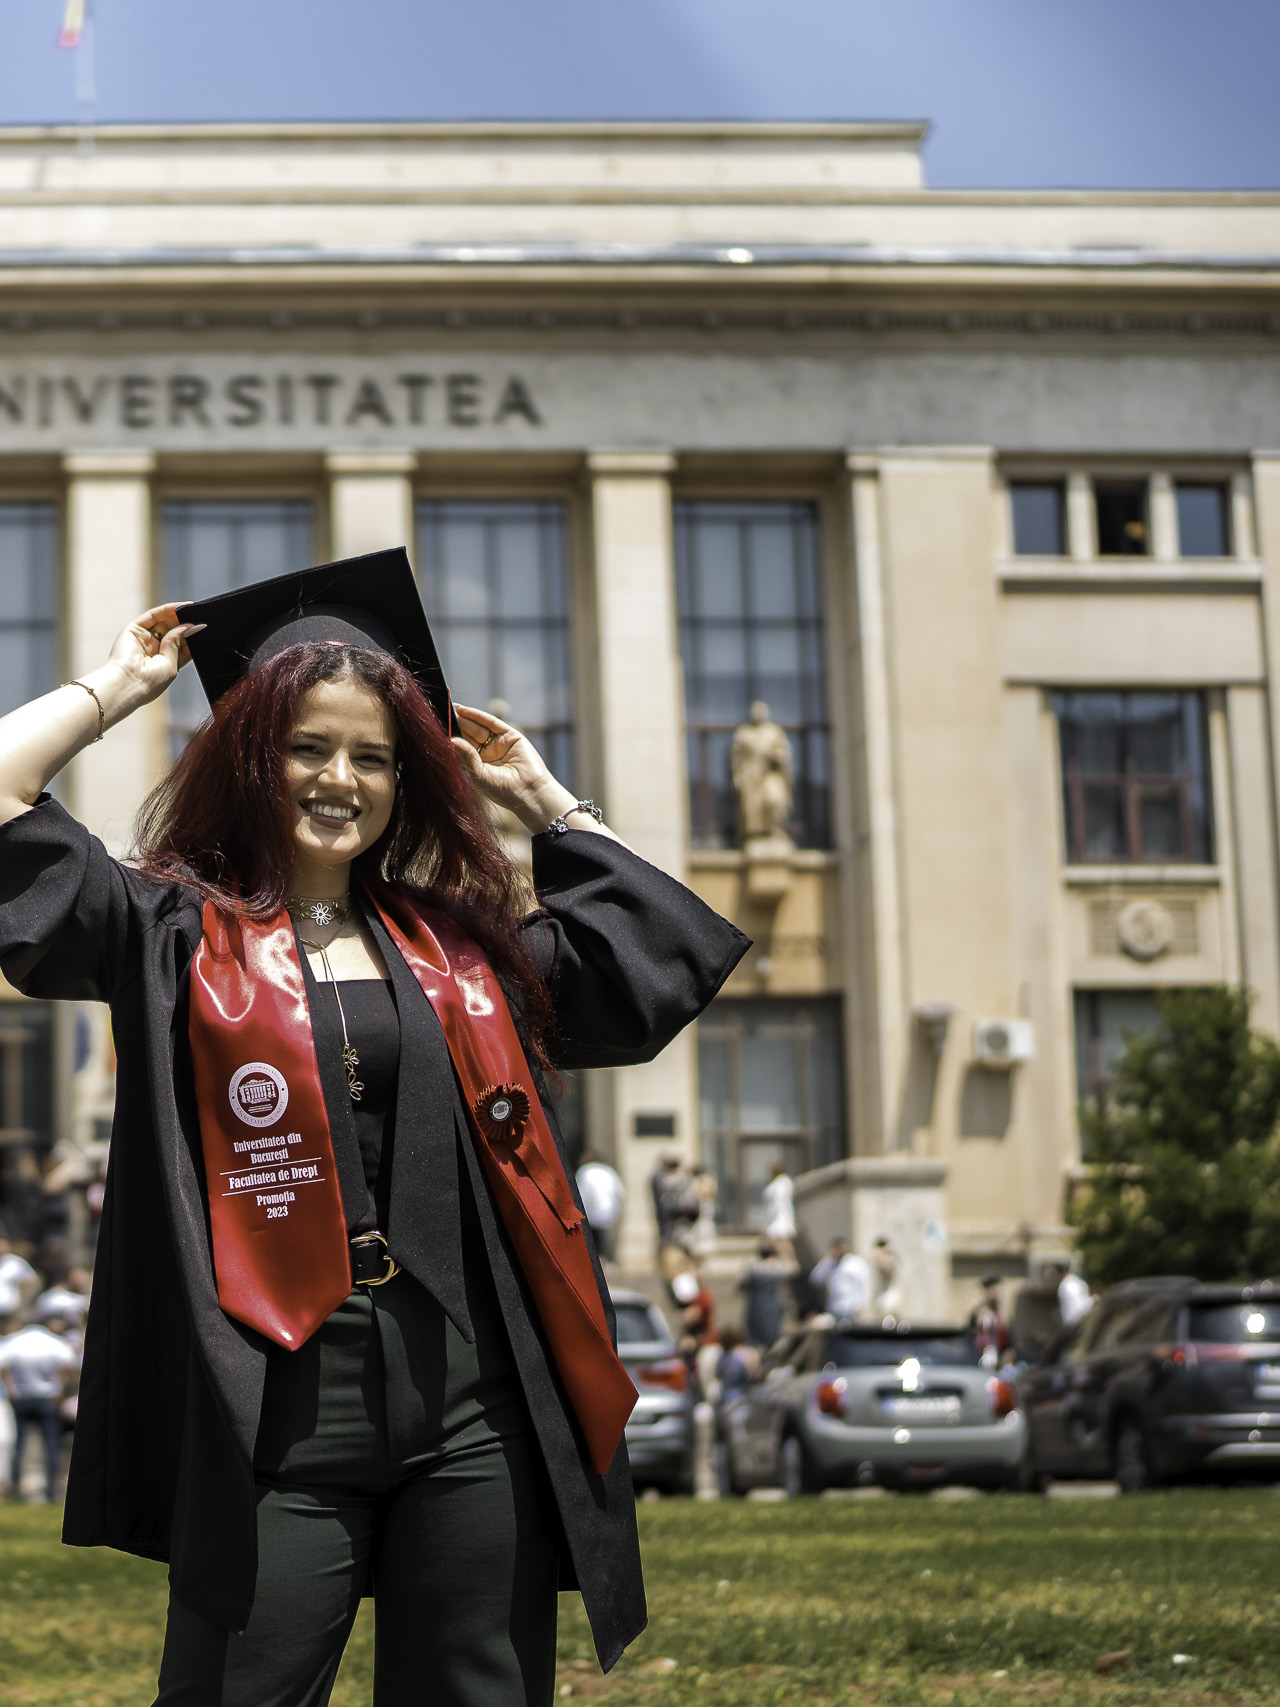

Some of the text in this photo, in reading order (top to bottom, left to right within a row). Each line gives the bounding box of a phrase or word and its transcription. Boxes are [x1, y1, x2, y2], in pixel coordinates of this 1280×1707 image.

[233, 1132, 302, 1153] Universitatea din
[250, 1148, 289, 1164] București
[228, 1164, 319, 1189] Facultatea de Drept
[256, 1191, 296, 1206] Promoția
[266, 1205, 289, 1219] 2023
